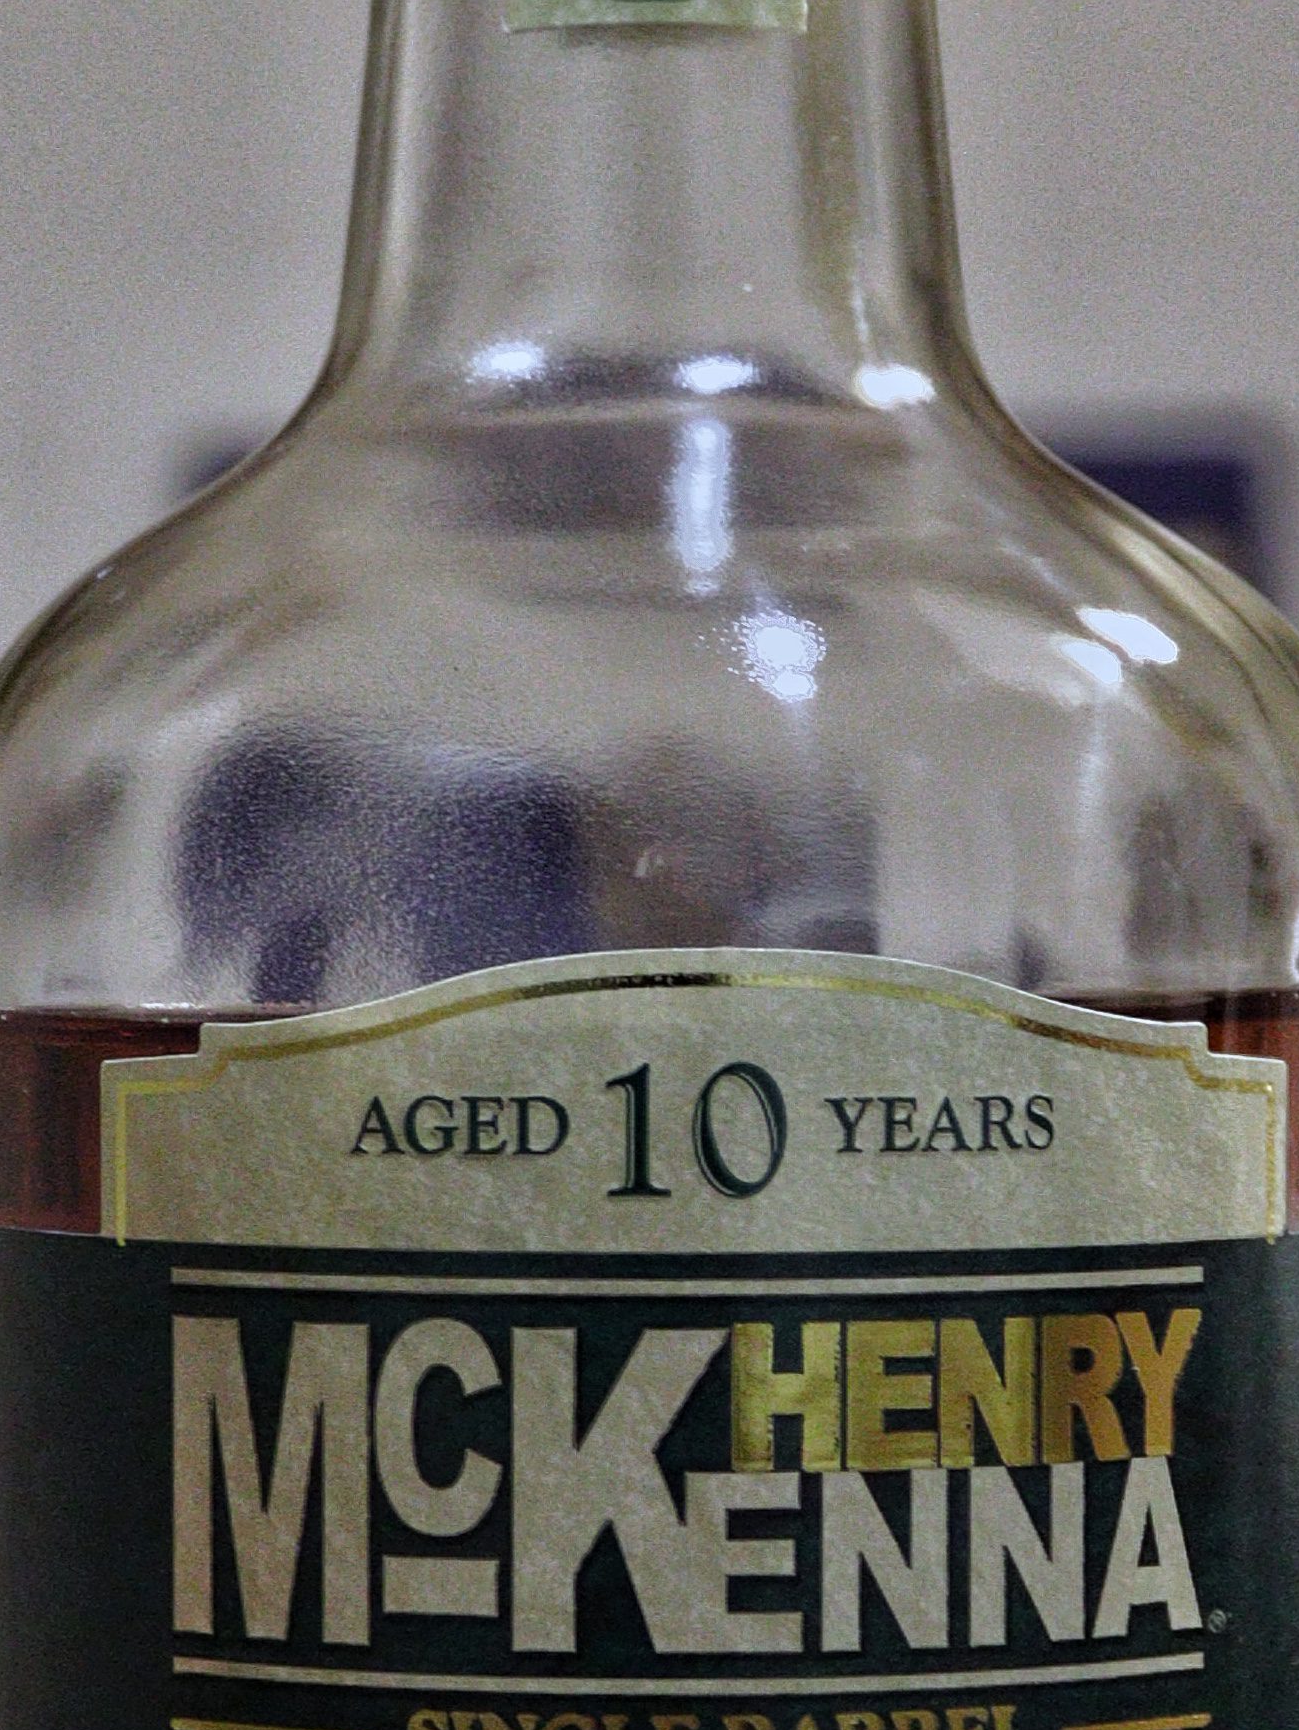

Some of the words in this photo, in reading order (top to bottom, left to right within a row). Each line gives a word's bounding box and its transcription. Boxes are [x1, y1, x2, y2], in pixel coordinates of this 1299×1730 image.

[350, 1095, 571, 1157] AGED
[605, 1060, 787, 1199] 10
[824, 1093, 1058, 1153] YEARS
[731, 1308, 1202, 1472] HENRY
